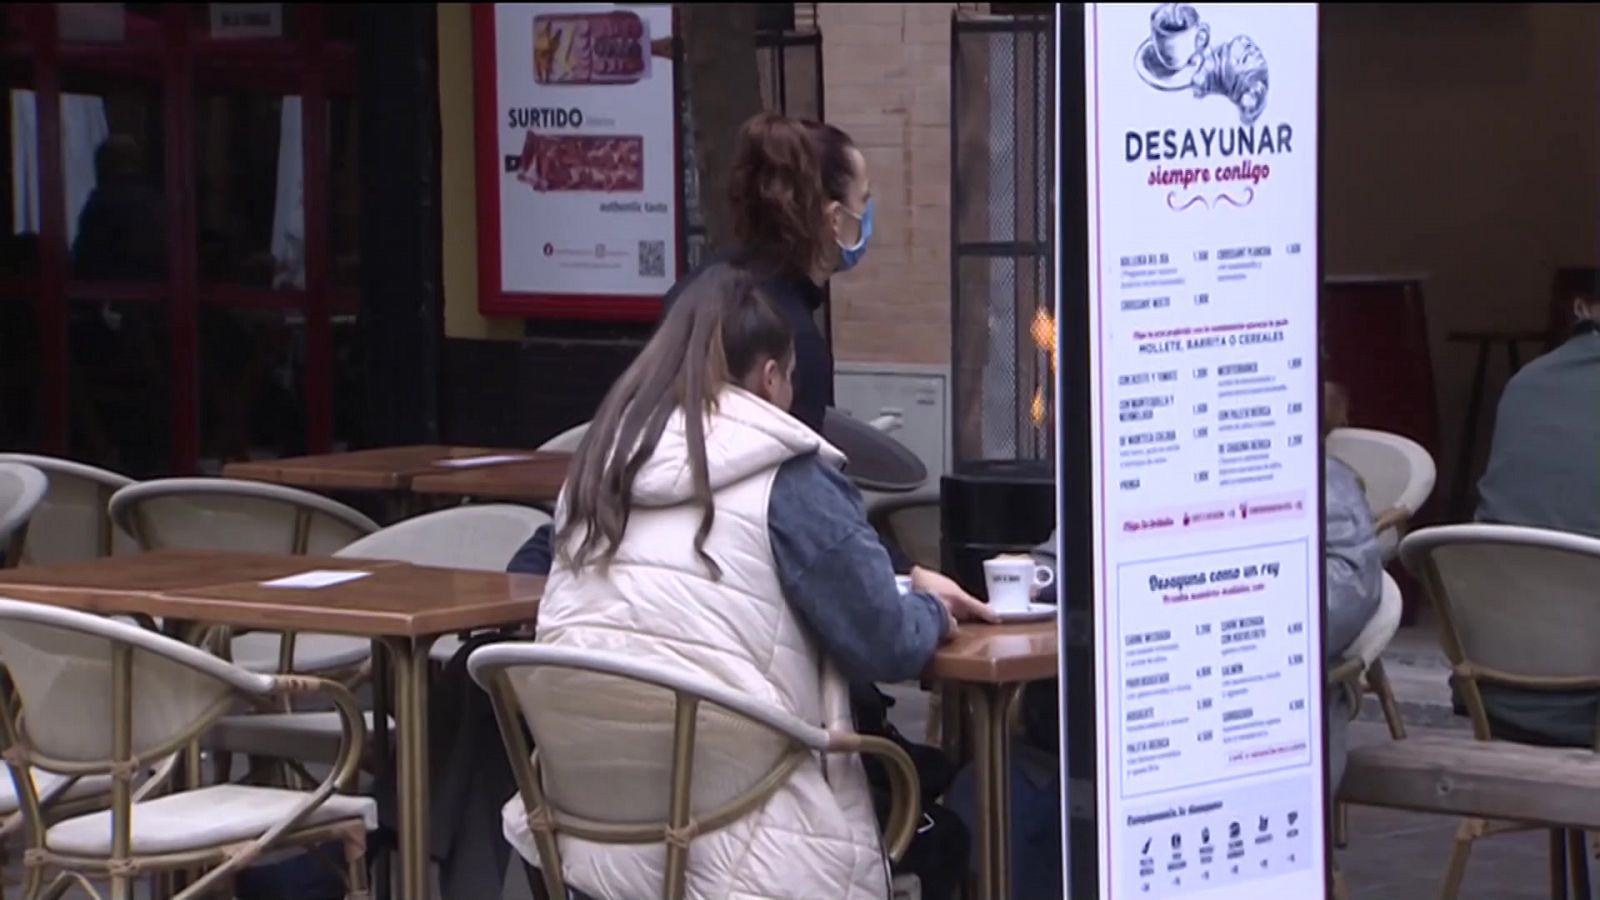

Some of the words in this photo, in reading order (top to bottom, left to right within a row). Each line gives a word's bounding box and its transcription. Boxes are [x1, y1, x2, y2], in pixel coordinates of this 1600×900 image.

[508, 107, 583, 128] SURTIDO
[1125, 123, 1293, 162] DESAYUNAR
[1147, 165, 1210, 190] siempre
[1215, 160, 1270, 186] contigo
[1239, 331, 1284, 345] CEREALES
[1149, 571, 1206, 593] Desayuna
[1209, 567, 1241, 584] como
[1243, 564, 1258, 578] un
[1261, 562, 1280, 578] rey
